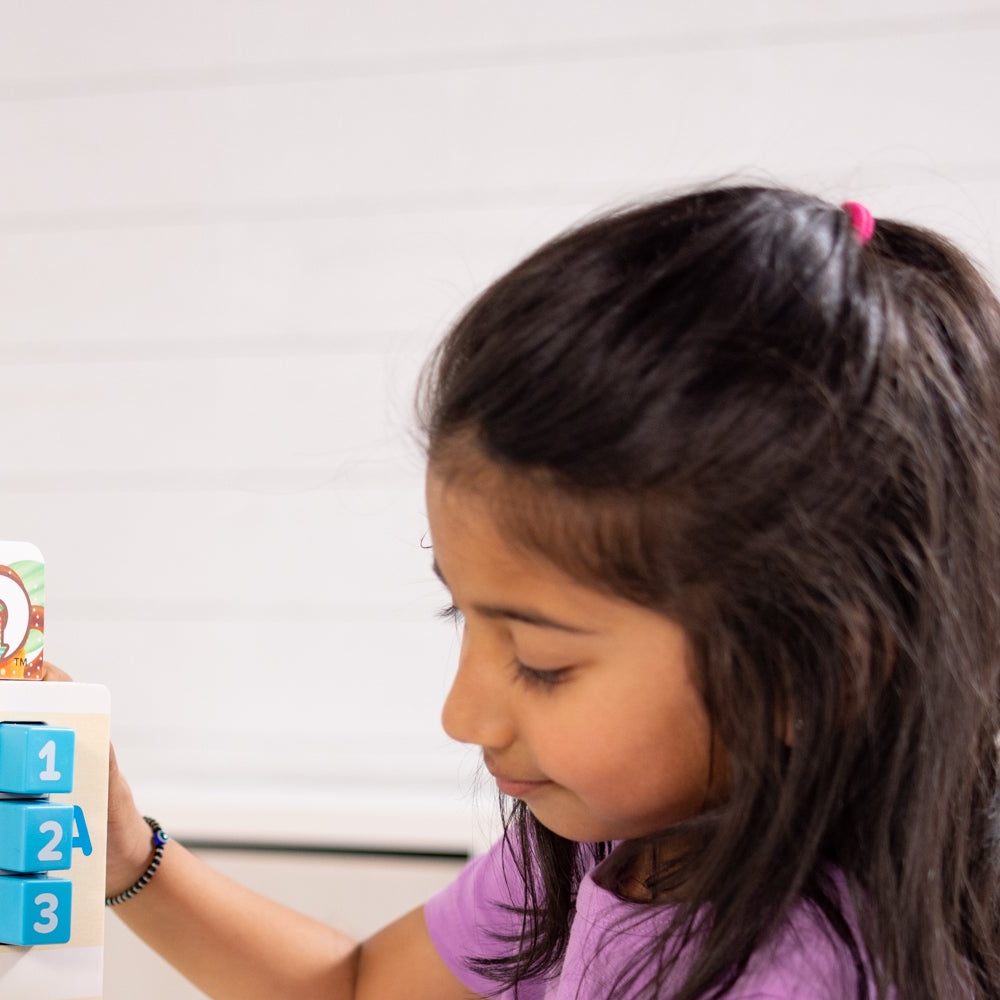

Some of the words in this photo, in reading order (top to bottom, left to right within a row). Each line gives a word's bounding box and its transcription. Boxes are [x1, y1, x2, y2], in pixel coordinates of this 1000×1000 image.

[38, 740, 62, 781] 1
[37, 820, 64, 862] 2
[33, 892, 59, 934] 3
